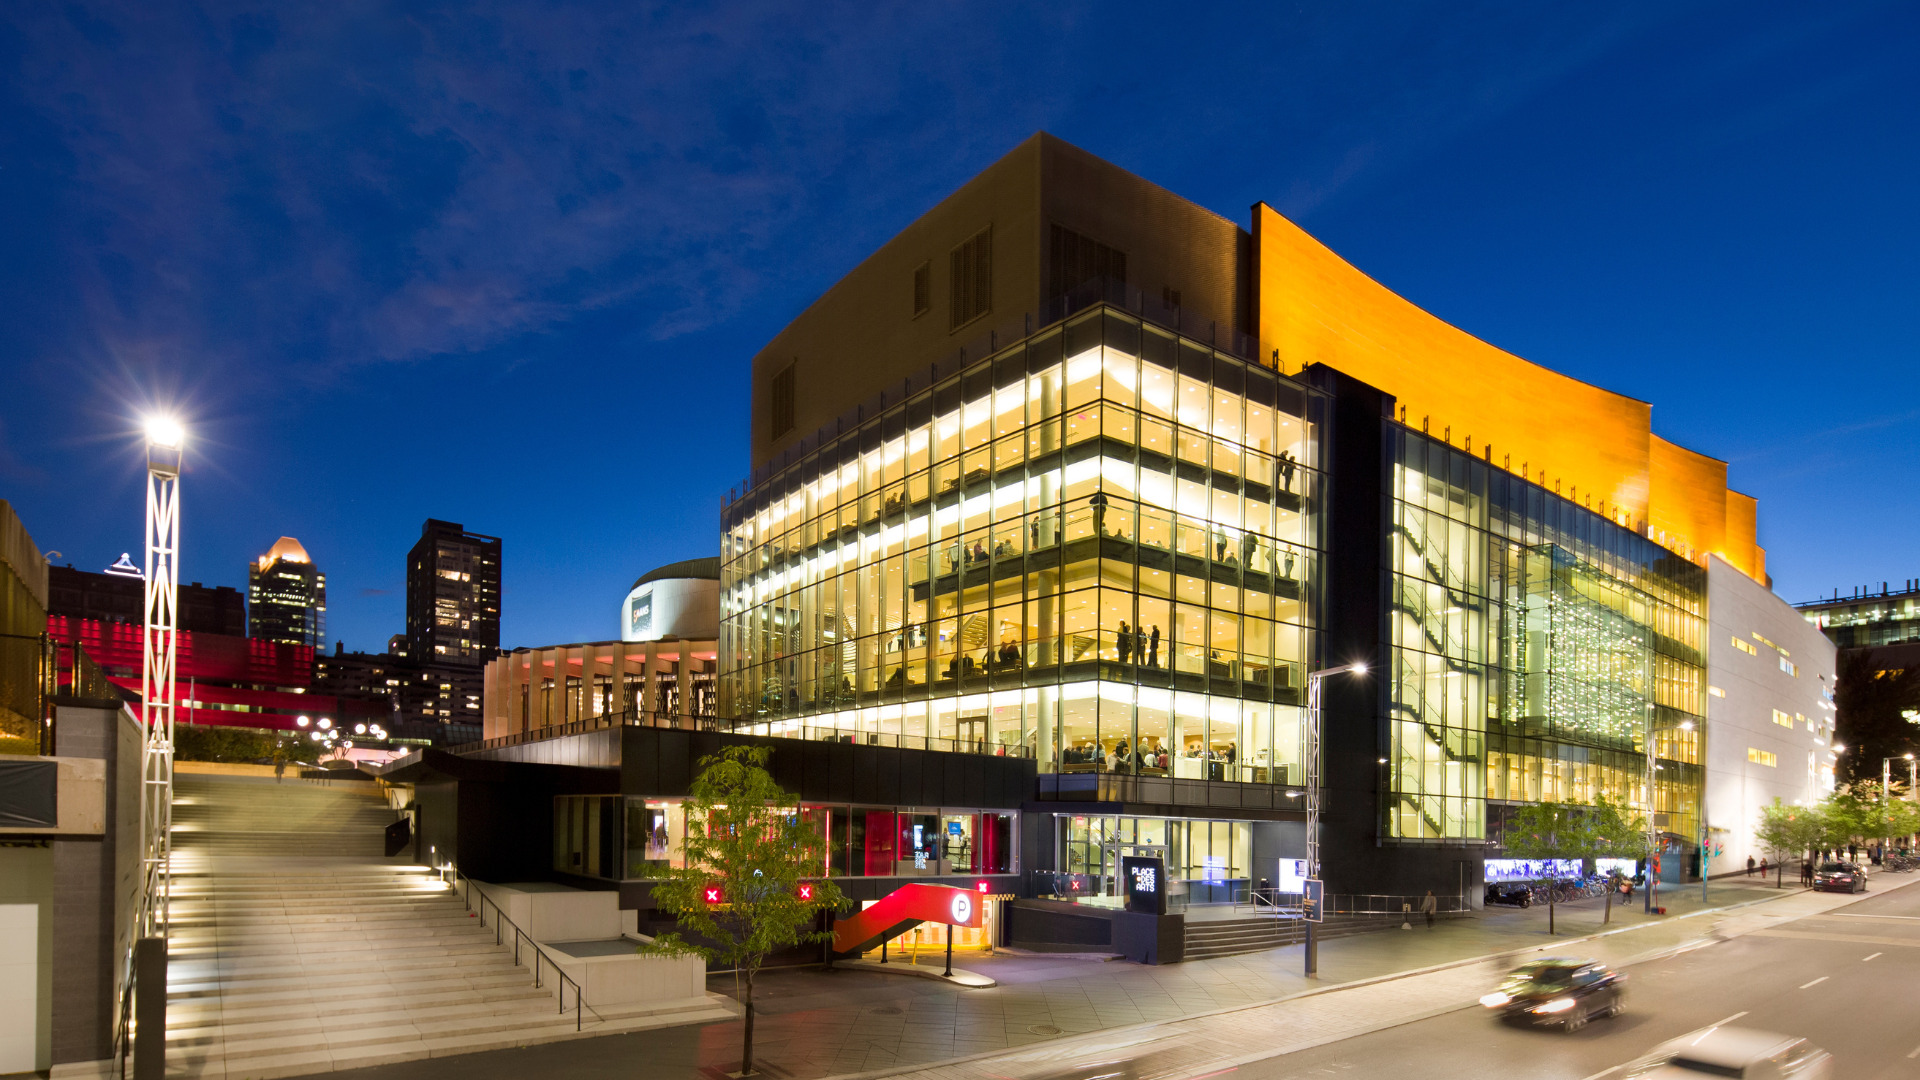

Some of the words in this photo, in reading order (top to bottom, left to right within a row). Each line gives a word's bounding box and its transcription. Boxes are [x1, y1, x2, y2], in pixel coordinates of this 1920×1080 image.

[1132, 866, 1154, 876] PLACE
[1141, 876, 1154, 884] DES
[1136, 883, 1154, 892] ARTS
[958, 900, 966, 916] P
